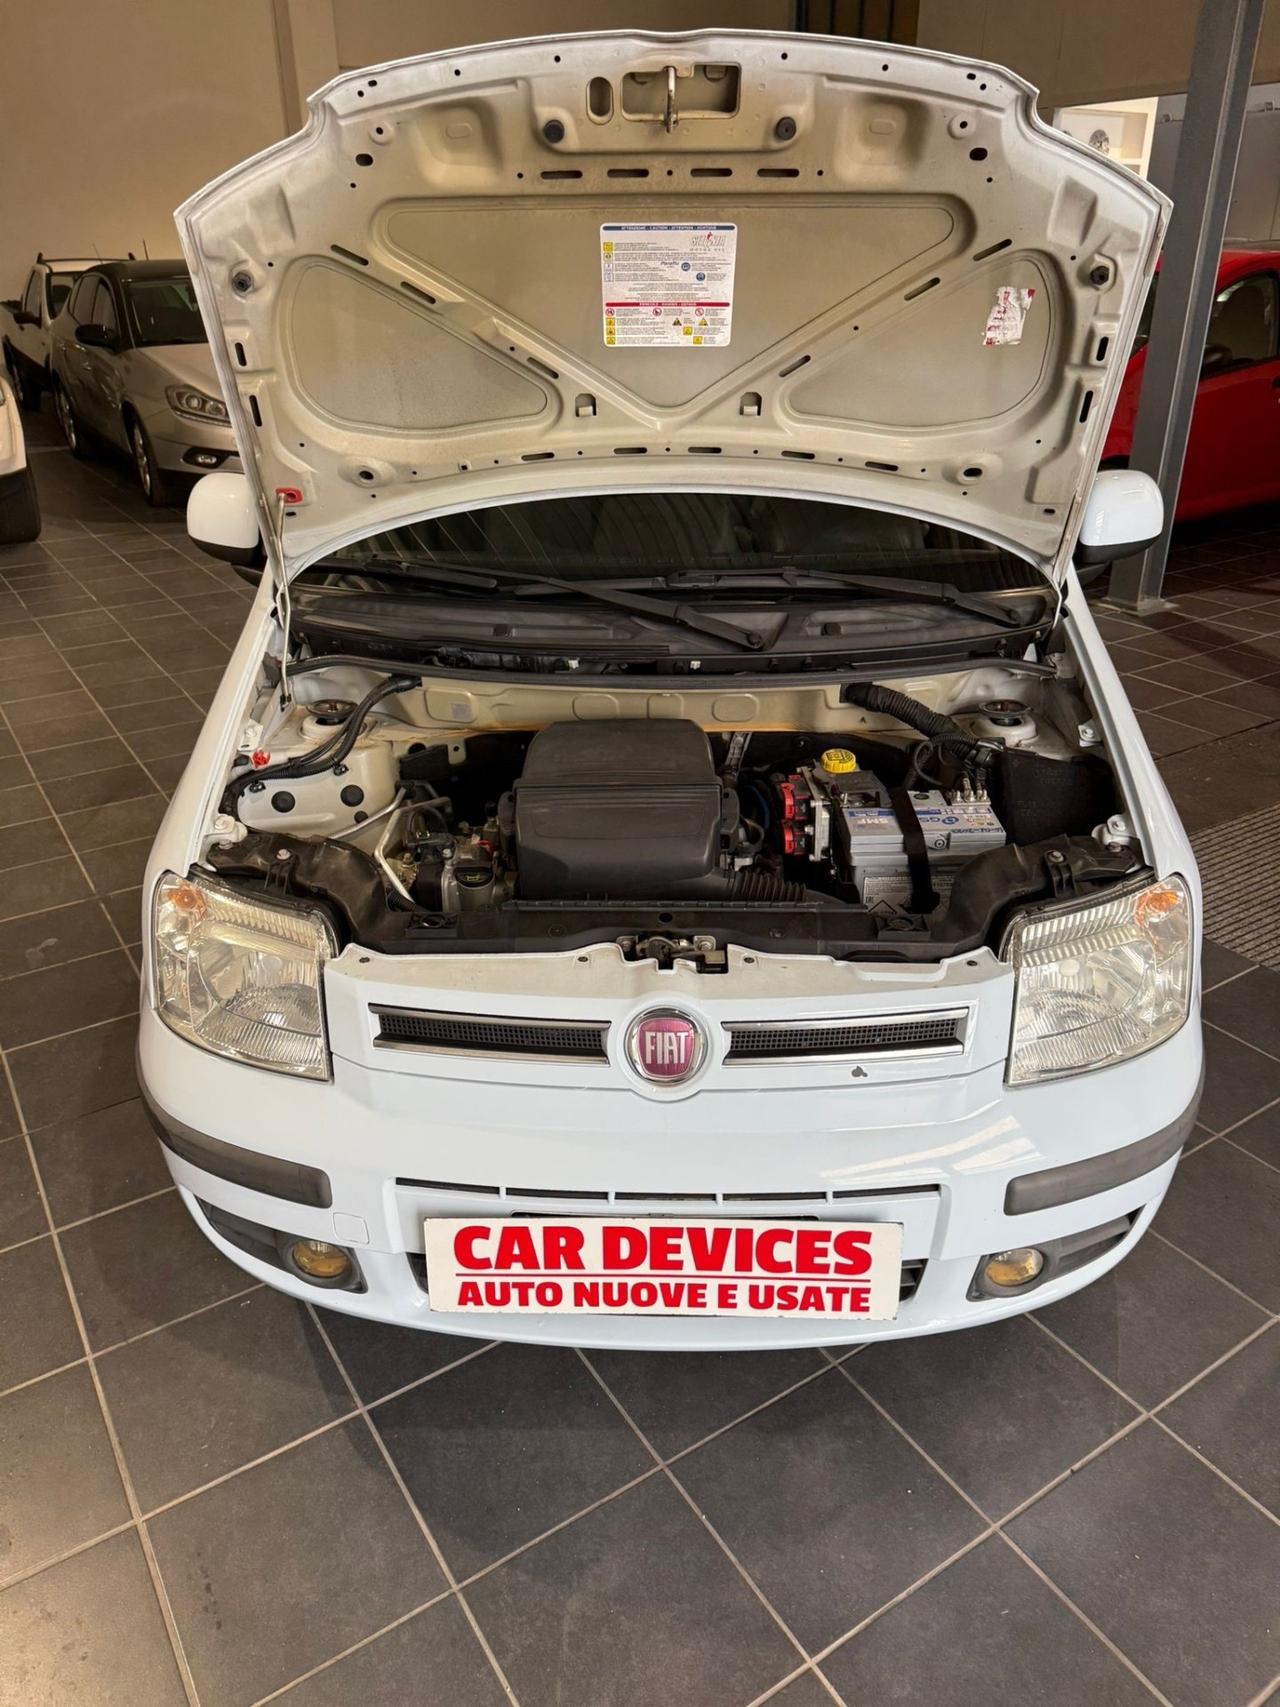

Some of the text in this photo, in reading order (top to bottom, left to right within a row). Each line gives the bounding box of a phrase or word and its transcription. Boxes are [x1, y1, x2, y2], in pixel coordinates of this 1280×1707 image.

[644, 1031, 689, 1064] FIAT
[454, 1225, 872, 1275] CAR DEVICES
[458, 1281, 871, 1312] AUTO NUOVE E USATE
